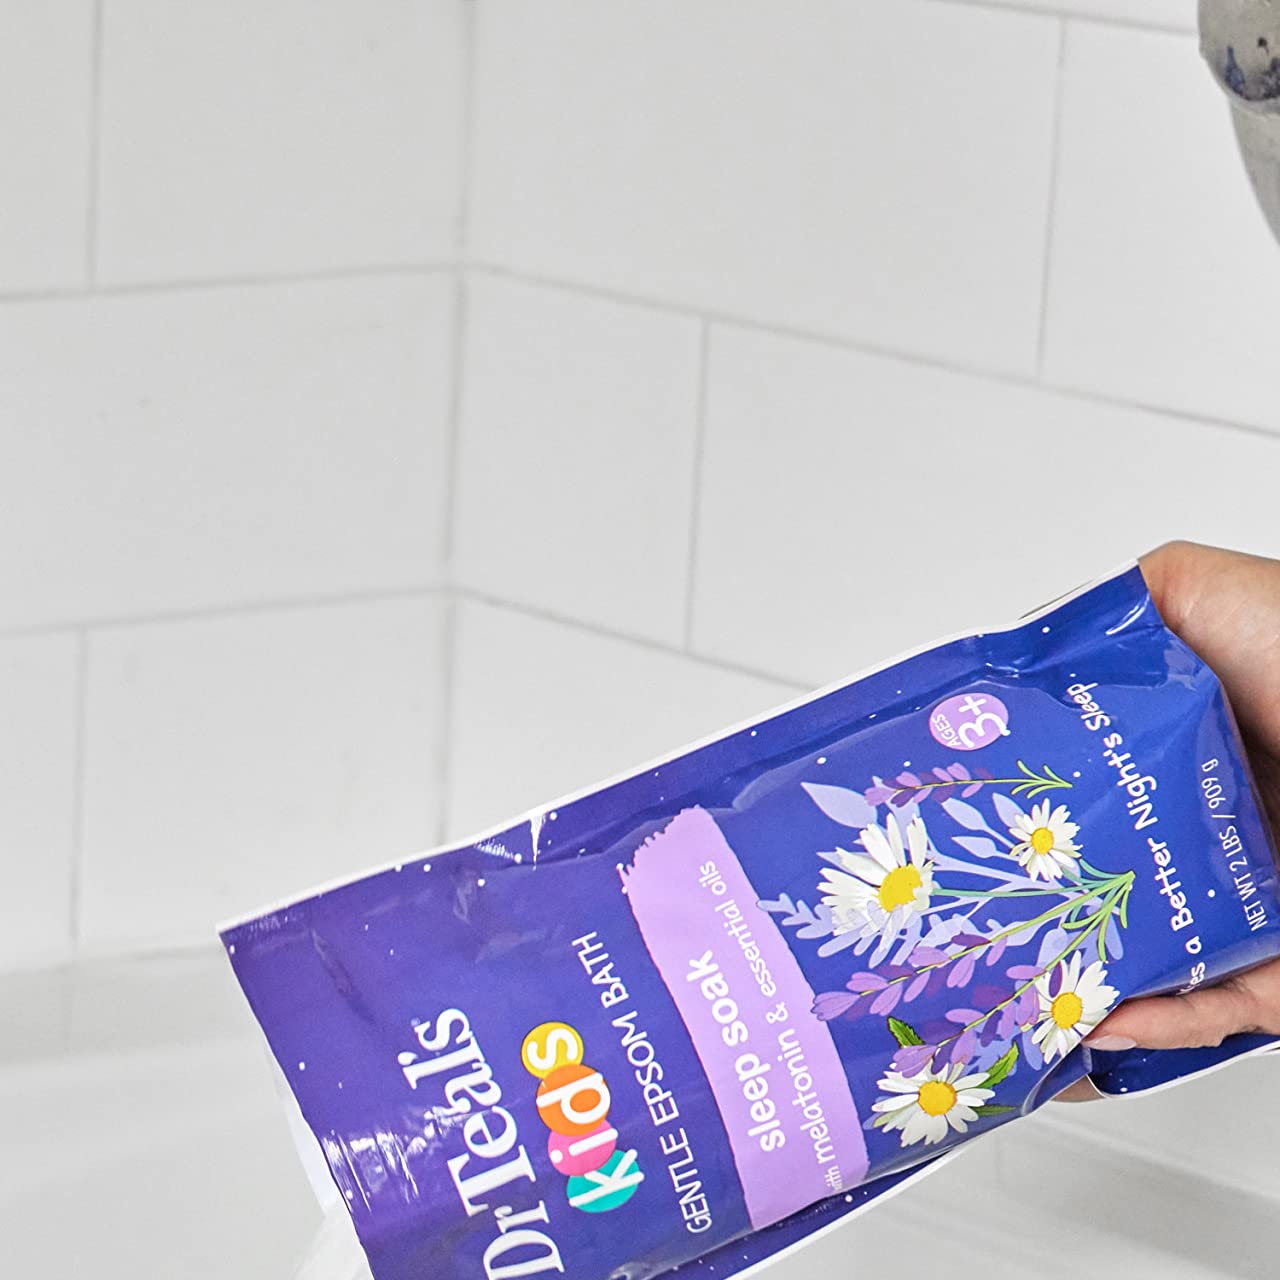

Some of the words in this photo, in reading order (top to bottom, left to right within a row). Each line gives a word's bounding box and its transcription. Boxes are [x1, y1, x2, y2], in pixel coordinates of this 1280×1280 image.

[932, 713, 962, 746] AGES
[958, 695, 1011, 748] 3+
[1066, 682, 1111, 731] Sleep
[1103, 732, 1159, 831] Night's
[1201, 758, 1219, 773] g
[1201, 777, 1227, 810] 909
[1218, 825, 1243, 858] LBS
[1229, 855, 1248, 872] 2
[698, 860, 728, 896] oils
[1147, 837, 1194, 932] Better
[1234, 872, 1257, 901] WT
[1243, 900, 1268, 932] NET
[571, 931, 629, 1009] BATH
[714, 899, 777, 997] essential
[1185, 935, 1202, 955] a
[686, 950, 749, 1047] soak
[765, 1001, 789, 1024] &
[611, 1010, 680, 1127] EPSOM
[397, 1008, 537, 1217] Teal's
[526, 1025, 645, 1208] kids
[734, 1053, 786, 1152] sleep
[777, 1028, 837, 1164] melatonin
[659, 1127, 713, 1233] GENTLE
